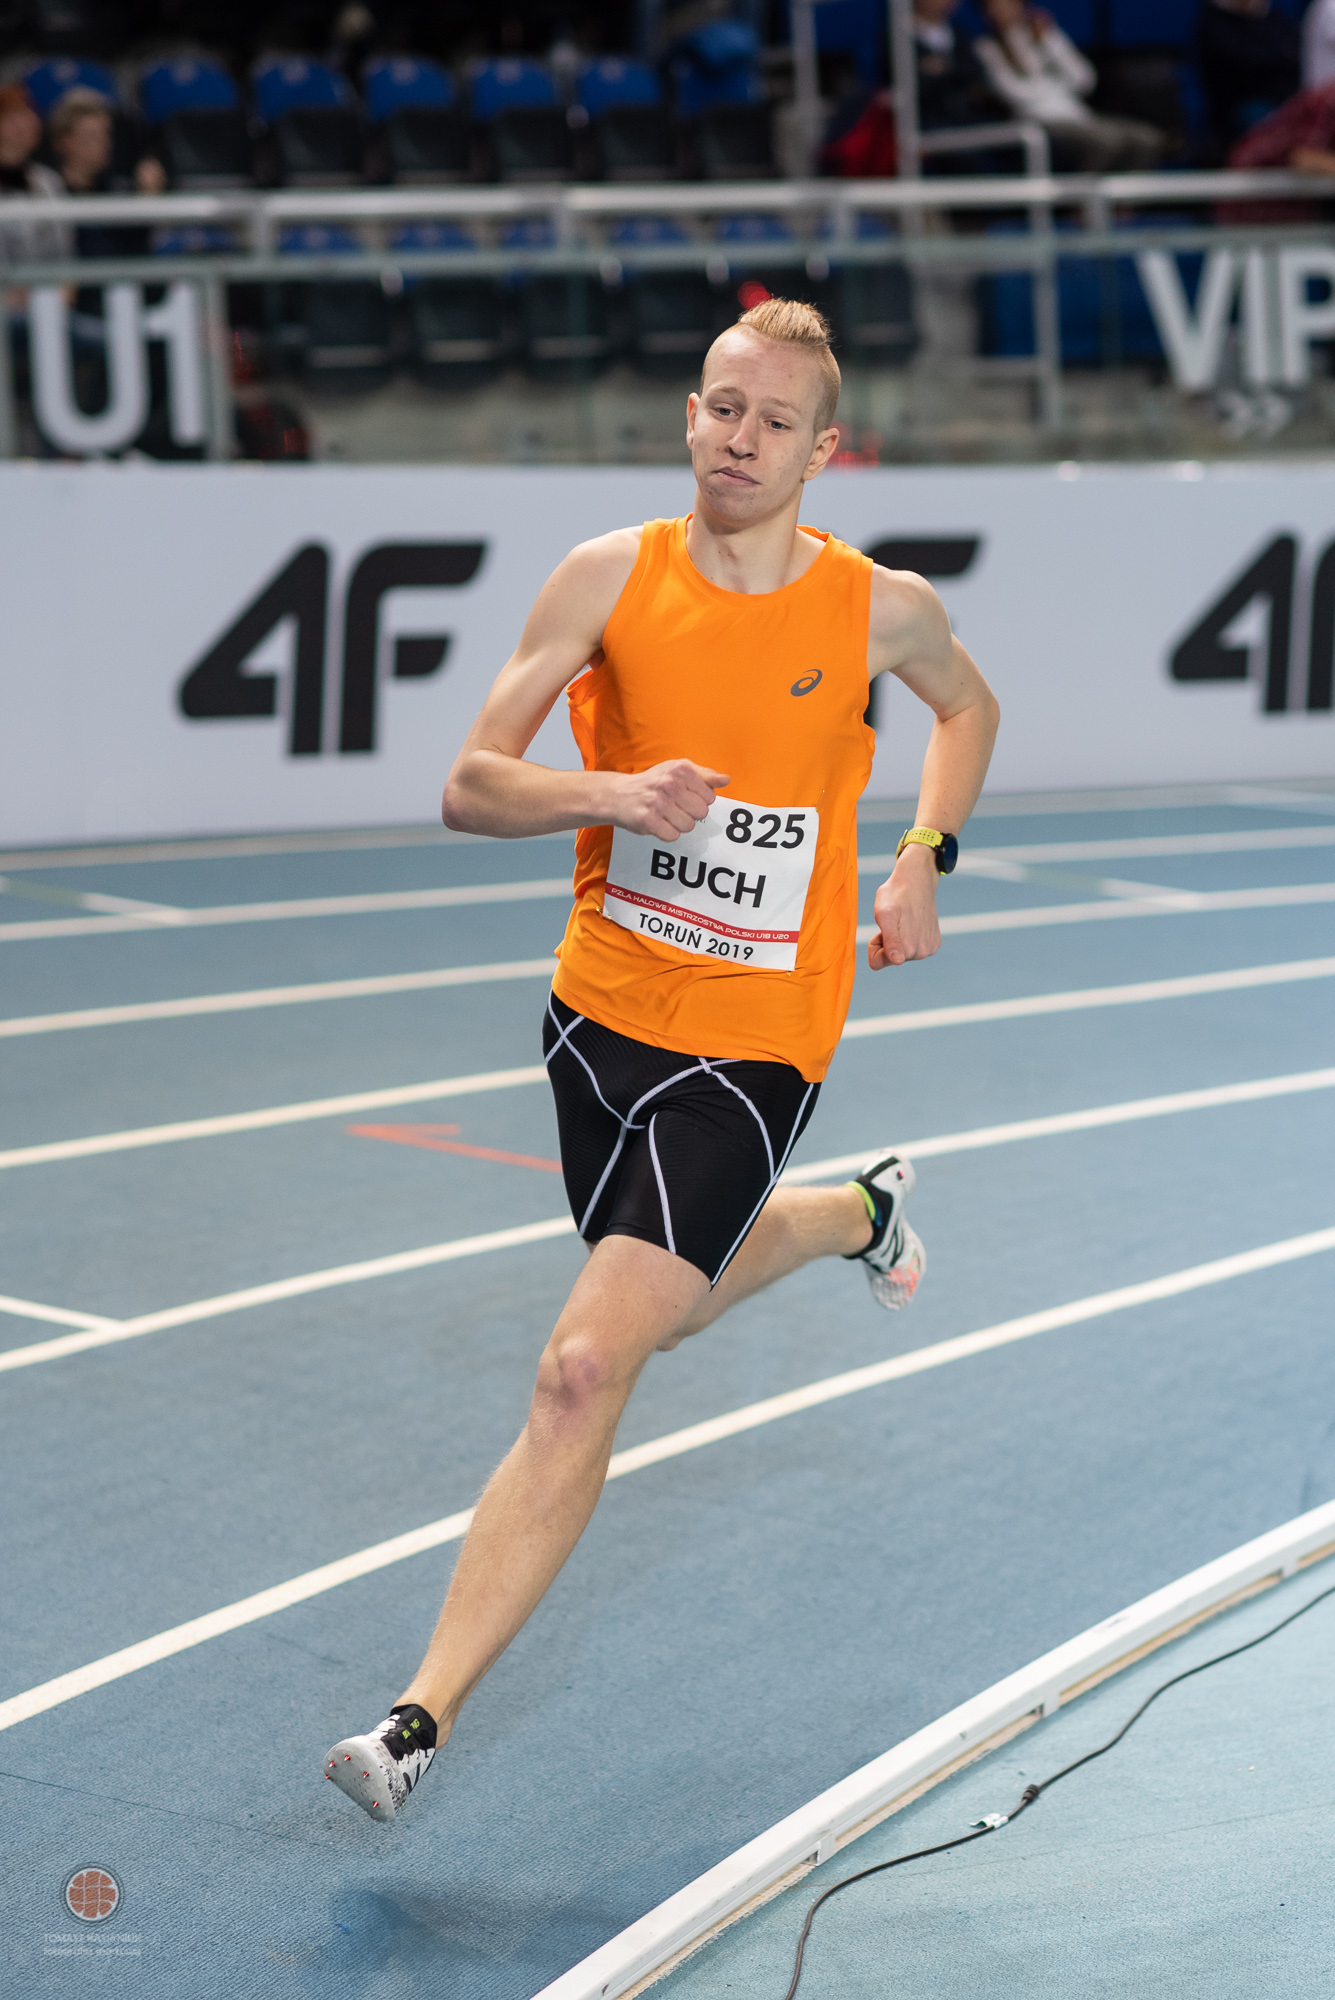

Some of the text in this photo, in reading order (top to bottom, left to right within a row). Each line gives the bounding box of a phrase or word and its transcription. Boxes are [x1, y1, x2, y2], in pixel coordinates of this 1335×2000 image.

[1134, 248, 1335, 388] VIP
[177, 537, 488, 757] 4F
[1167, 527, 1335, 714] 4
[725, 808, 806, 849] 825
[650, 848, 767, 909] BUCH
[611, 887, 632, 900] PZLA
[633, 895, 667, 911] HALOWE
[667, 906, 724, 932] MISTRZOSTWA
[725, 927, 756, 938] POLSKI
[639, 912, 754, 961] TORUŃ 2019
